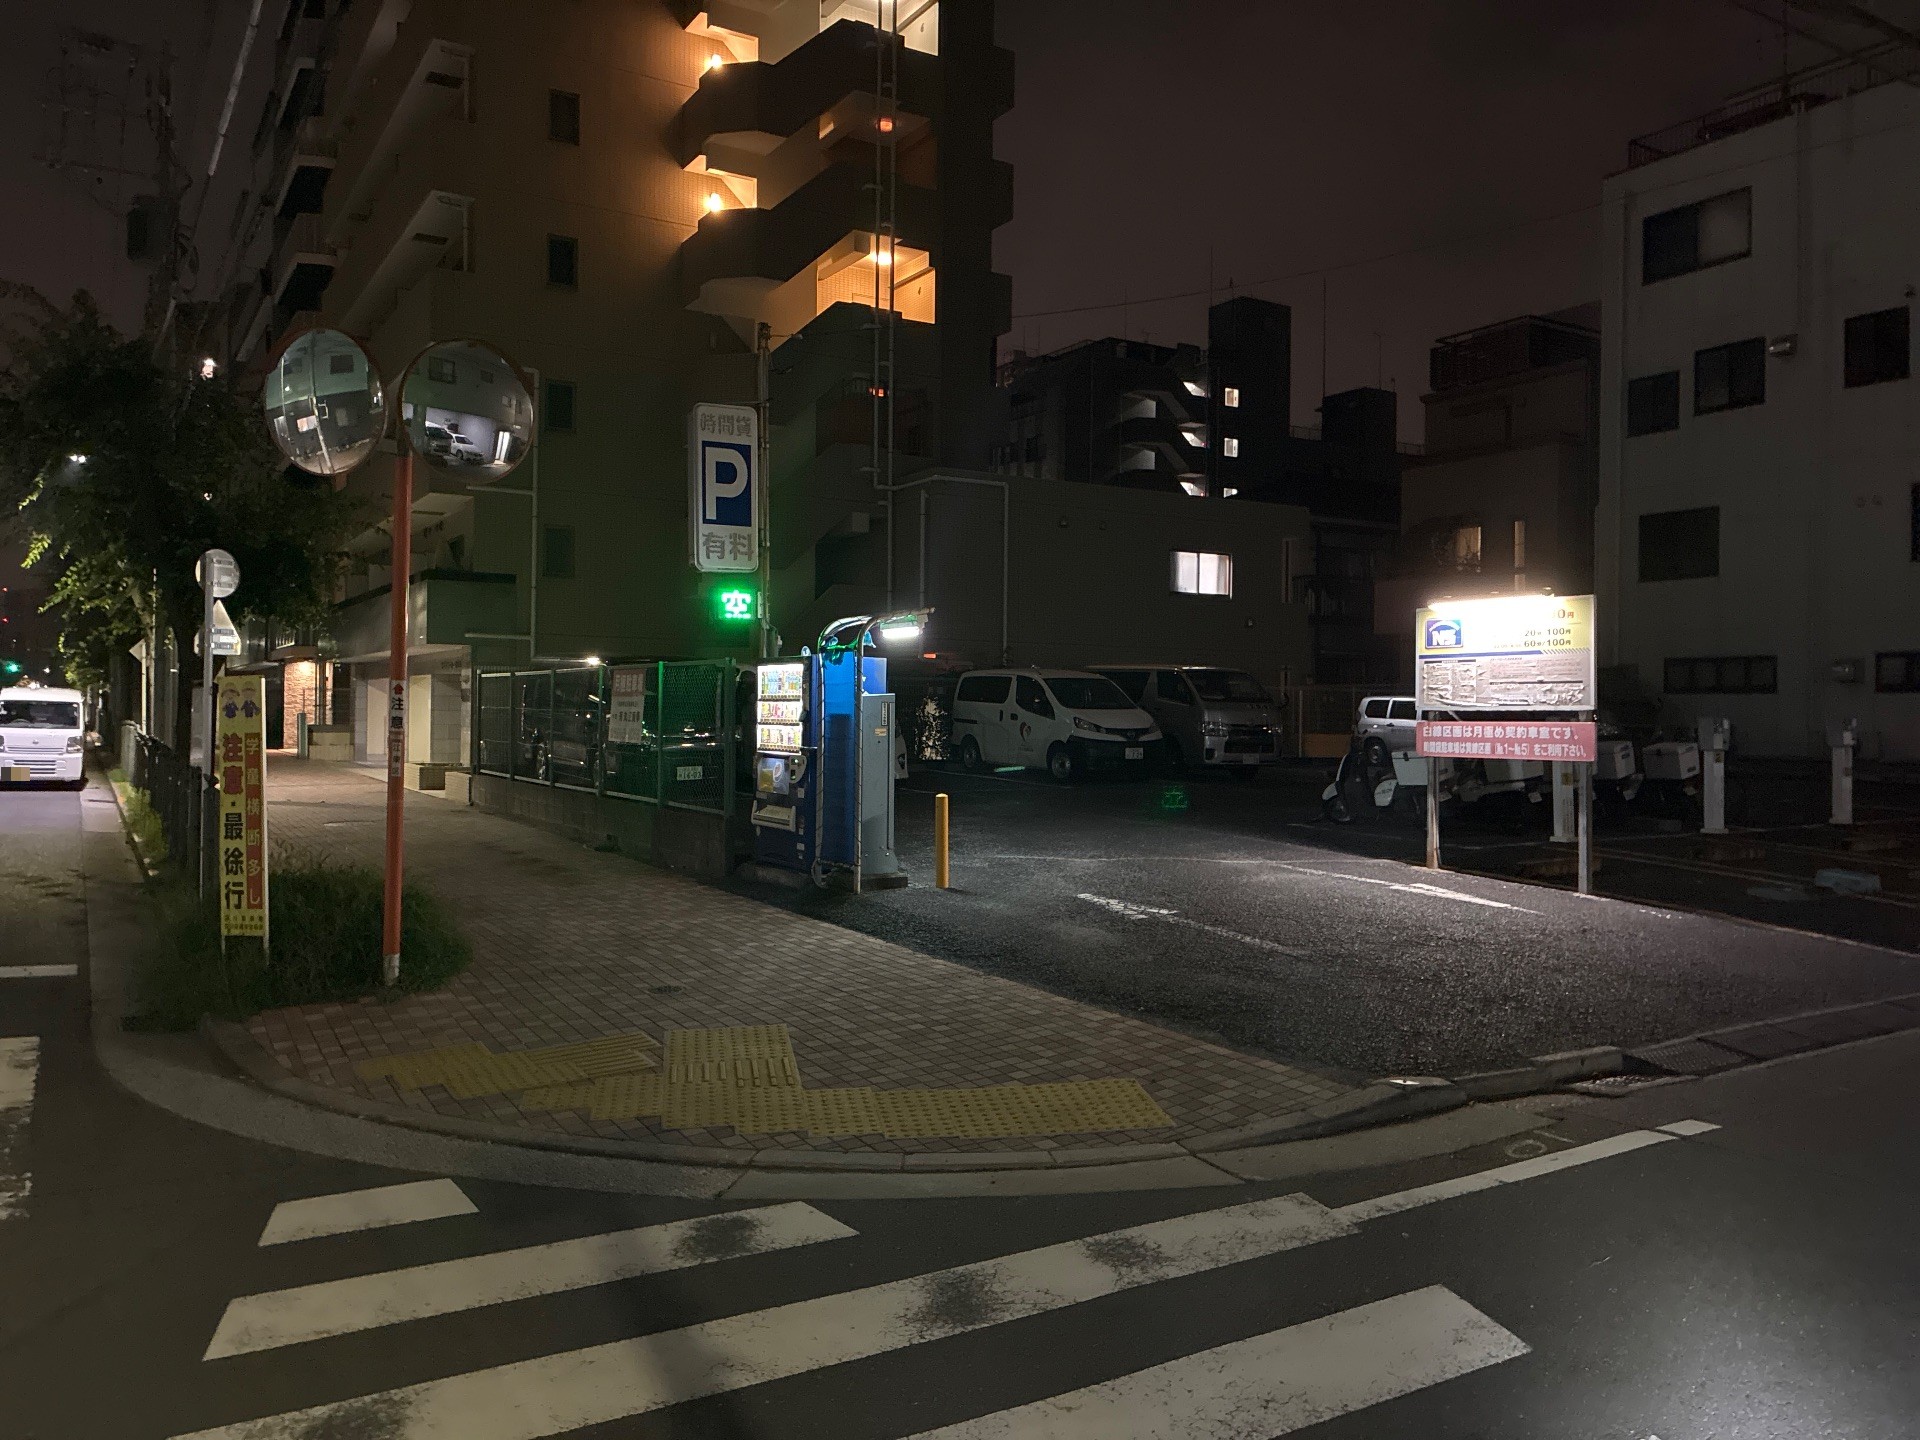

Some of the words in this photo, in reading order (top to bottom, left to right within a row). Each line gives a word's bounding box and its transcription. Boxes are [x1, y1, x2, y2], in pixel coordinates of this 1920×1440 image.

[705, 446, 748, 520] P
[701, 531, 753, 562] 有料
[245, 737, 261, 905] 学童横断多し
